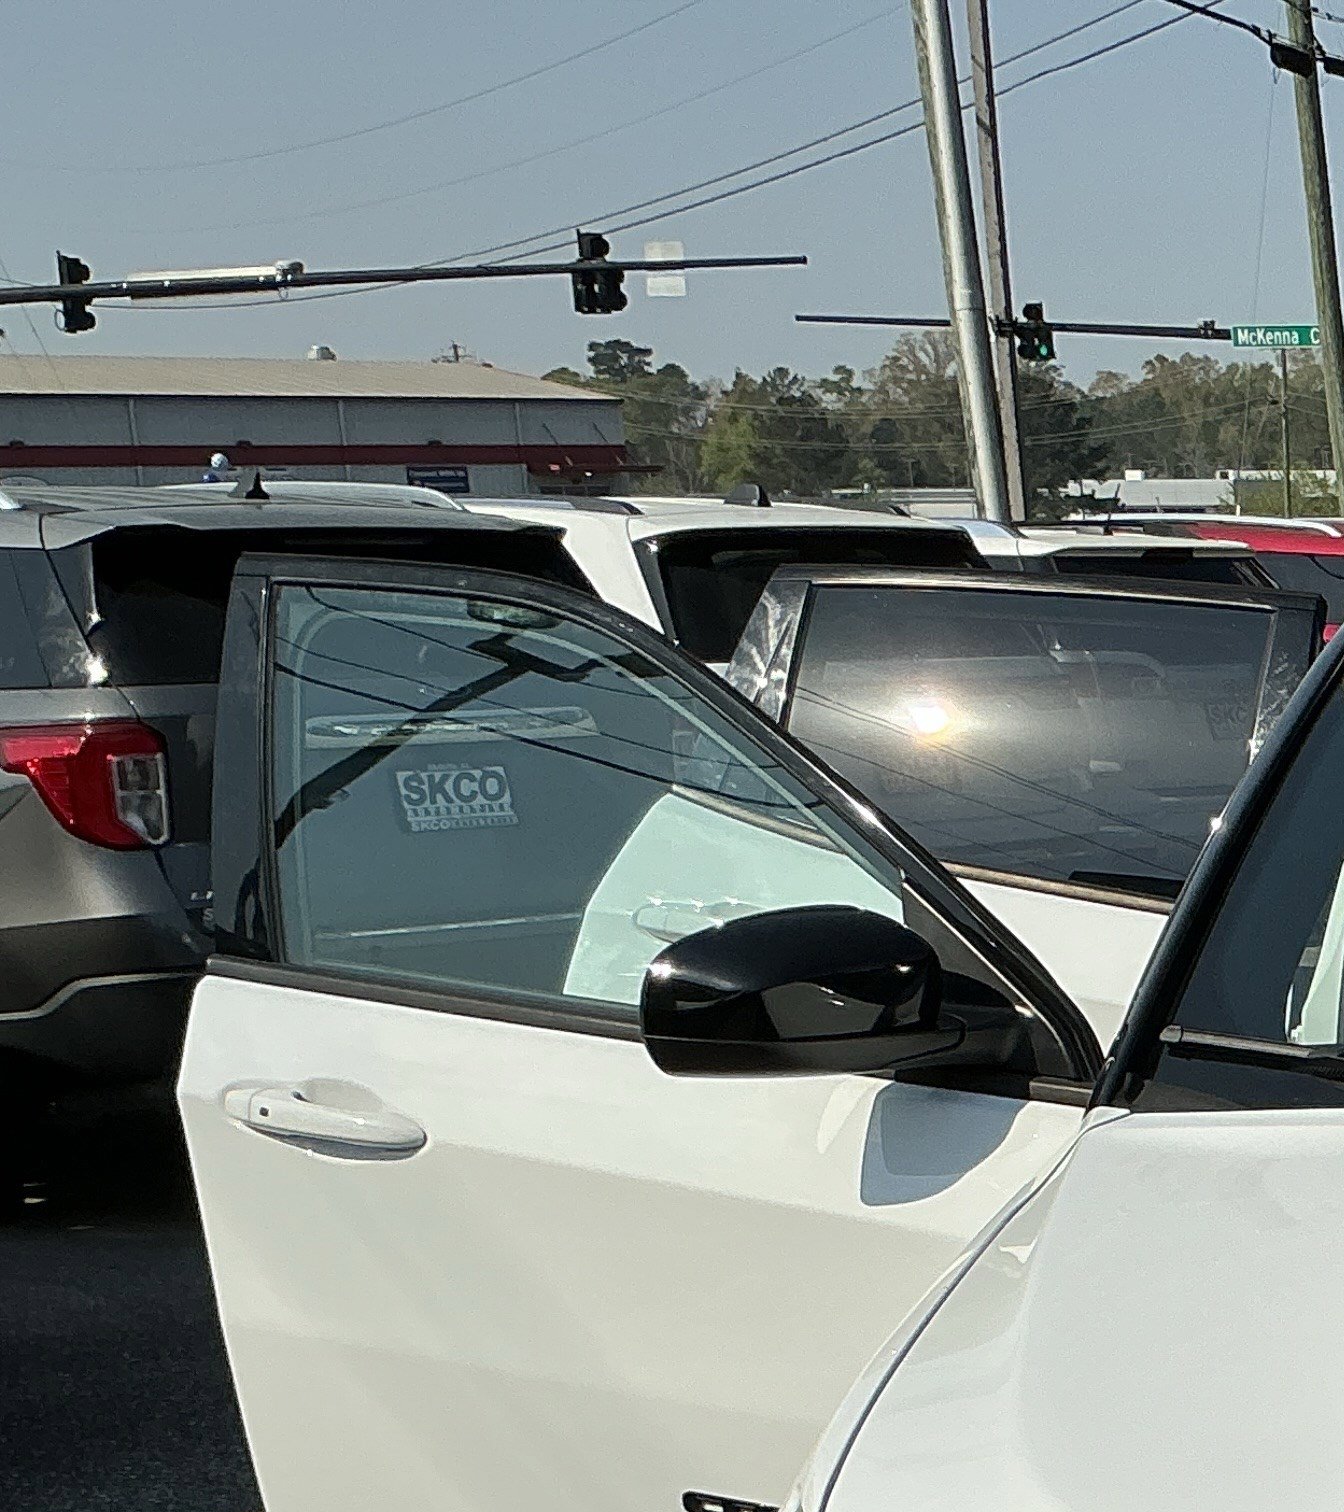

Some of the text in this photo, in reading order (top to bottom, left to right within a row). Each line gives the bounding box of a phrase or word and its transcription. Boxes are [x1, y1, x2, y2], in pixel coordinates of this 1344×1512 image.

[1237, 328, 1321, 345] McKenna C
[403, 771, 507, 806] SKCO
